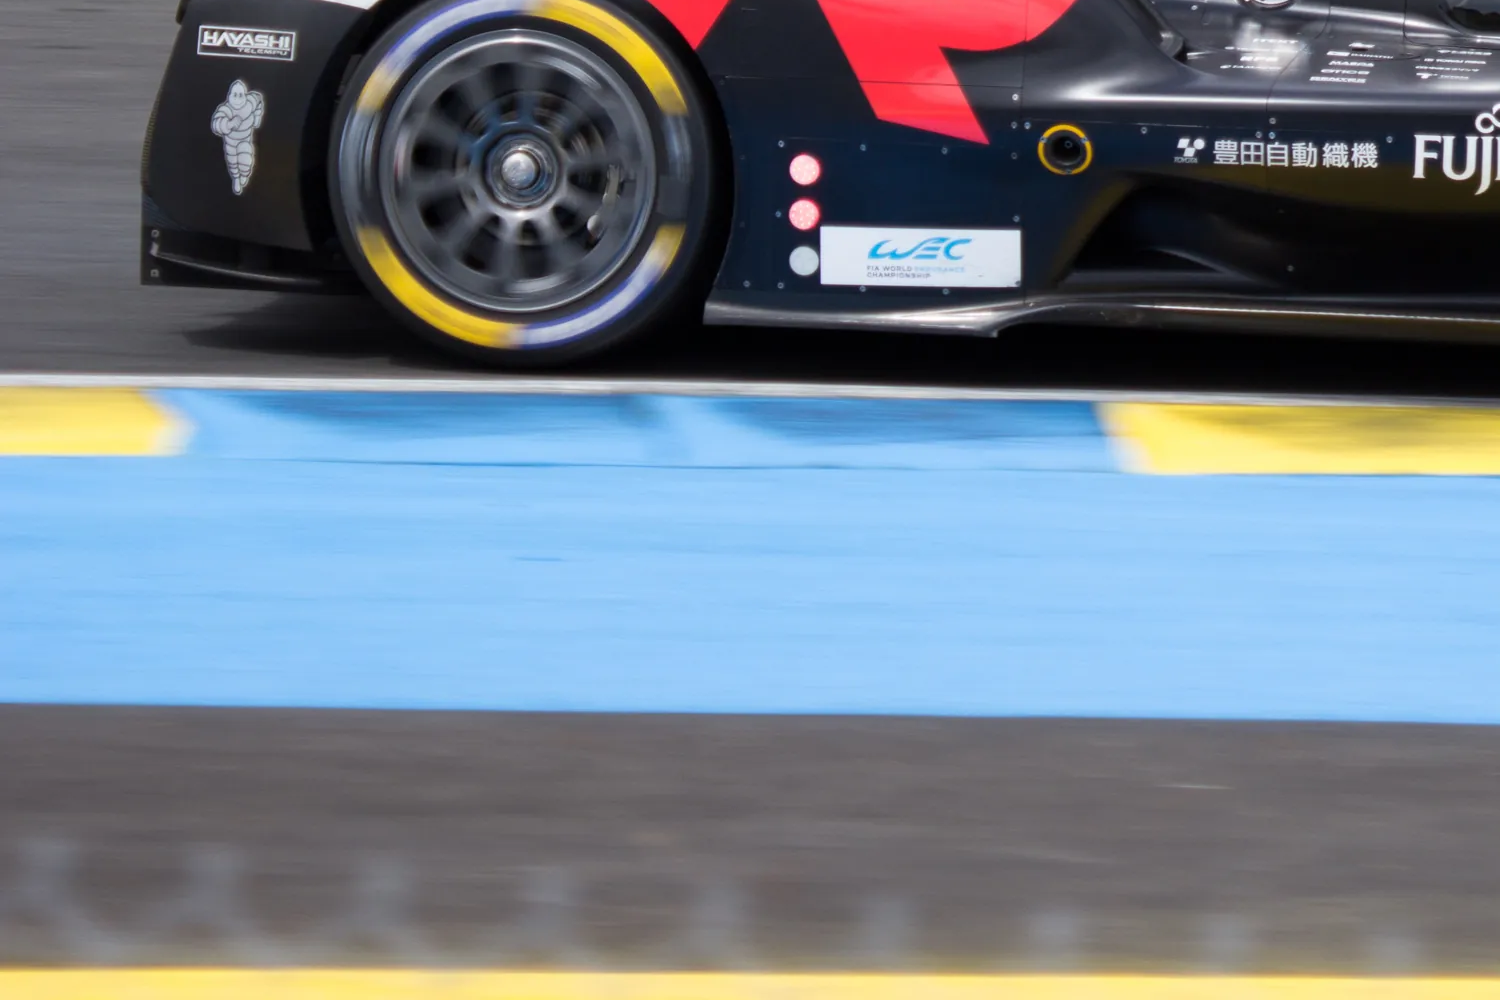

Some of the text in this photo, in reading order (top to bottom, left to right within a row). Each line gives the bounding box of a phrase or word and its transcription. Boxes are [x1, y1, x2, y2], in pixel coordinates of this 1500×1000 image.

[201, 30, 290, 51] HAYASHI
[237, 47, 287, 56] TELEMPU
[868, 237, 972, 260] WEC
